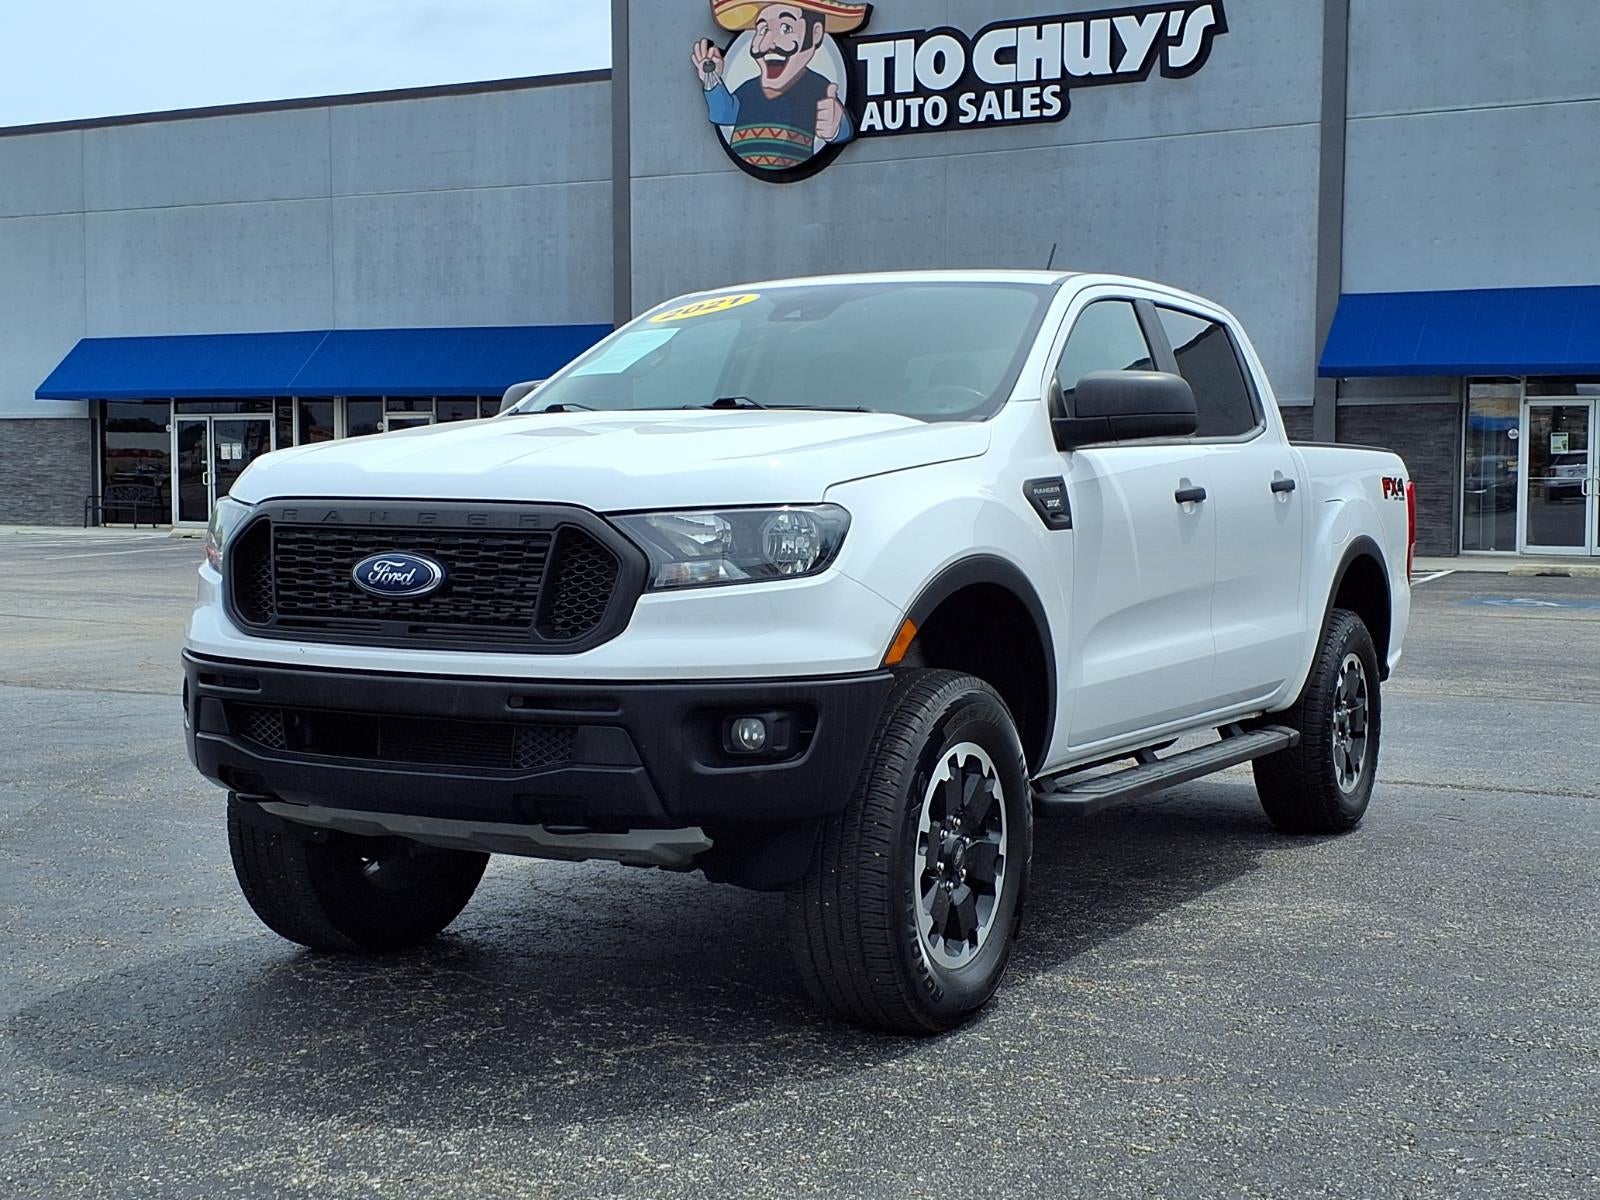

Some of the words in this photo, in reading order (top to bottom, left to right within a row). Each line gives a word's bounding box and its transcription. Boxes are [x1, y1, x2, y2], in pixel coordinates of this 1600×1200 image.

[857, 34, 966, 96] TIO
[972, 5, 1216, 85] CHUY'S
[860, 95, 948, 132] AUTO
[958, 84, 1062, 124] SALES
[658, 295, 746, 321] 2021
[1381, 476, 1405, 500] FX4
[281, 508, 542, 528] RANGER
[367, 560, 417, 586] Ford
